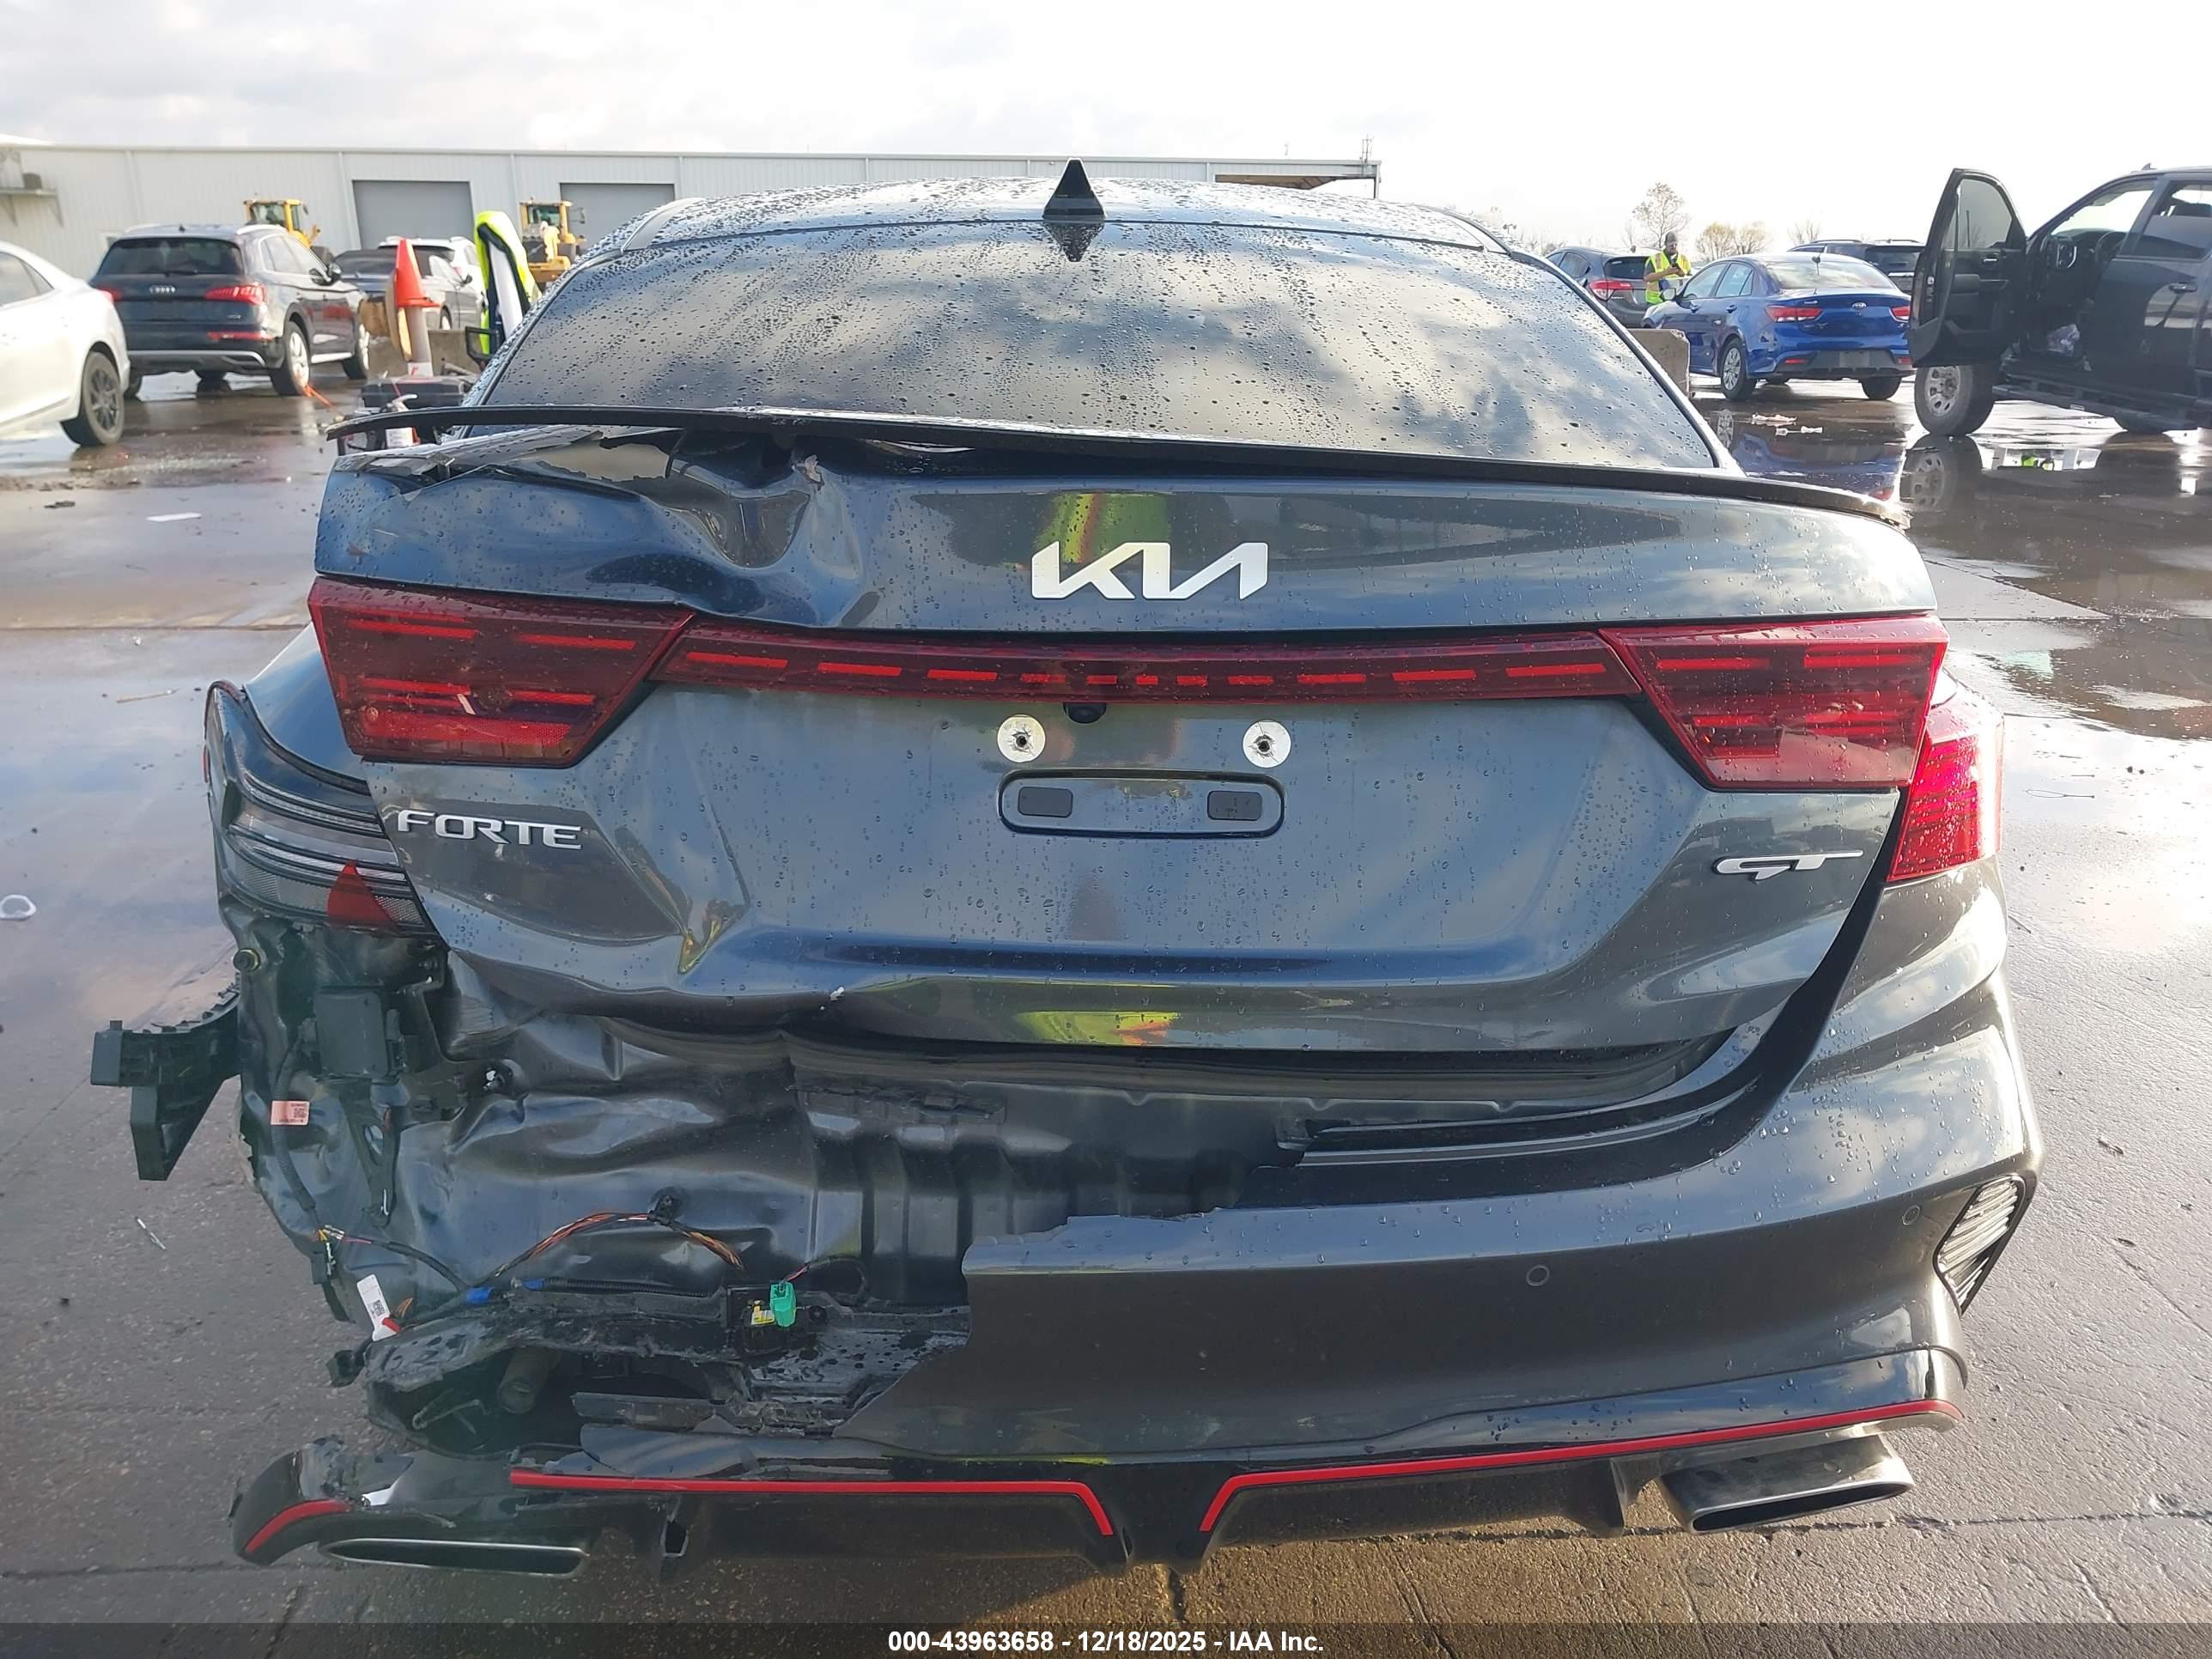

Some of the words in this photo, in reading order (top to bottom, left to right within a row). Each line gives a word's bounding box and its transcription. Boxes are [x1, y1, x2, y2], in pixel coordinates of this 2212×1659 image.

[1031, 541, 1268, 599] KIA
[398, 809, 581, 850] FORTE
[1716, 849, 1864, 880] GT
